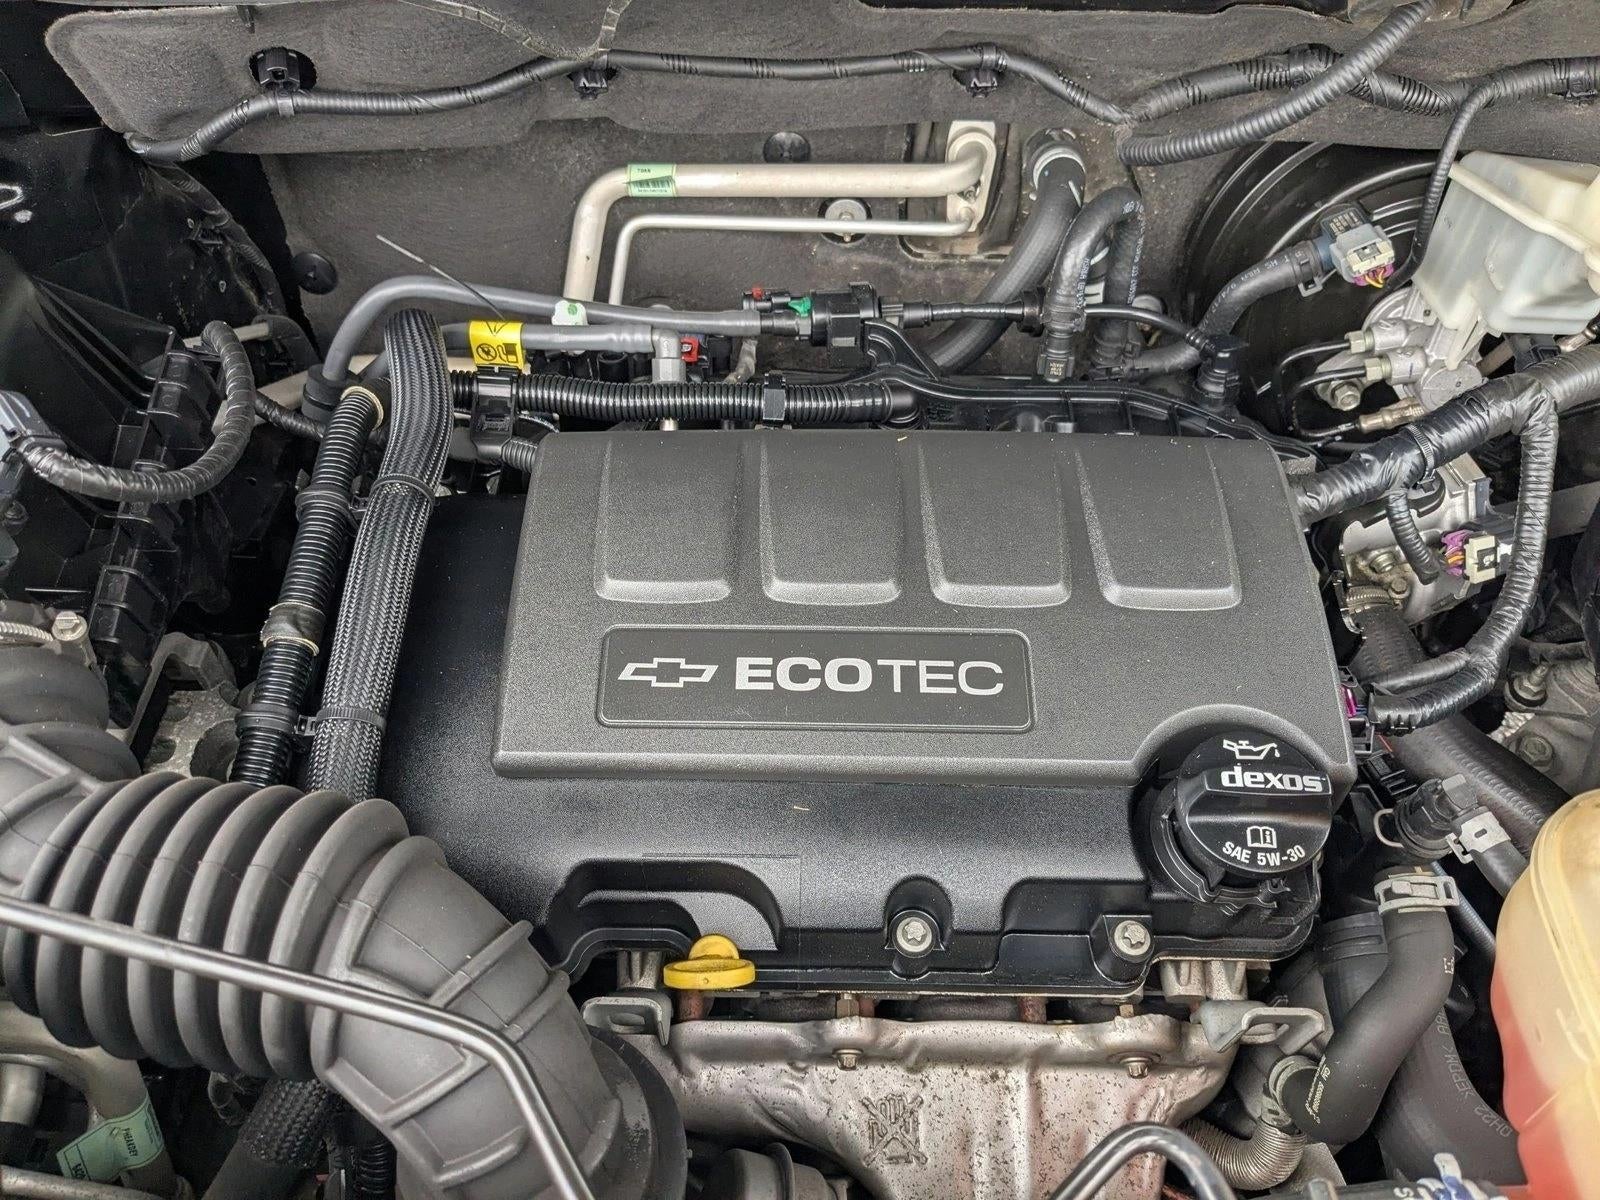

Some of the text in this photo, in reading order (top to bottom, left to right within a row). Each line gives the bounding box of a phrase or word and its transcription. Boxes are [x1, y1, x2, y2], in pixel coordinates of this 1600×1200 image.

[735, 656, 1004, 696] ECOTEC
[1220, 765, 1323, 792] dexos
[1222, 841, 1306, 867] SAE 5W-30
